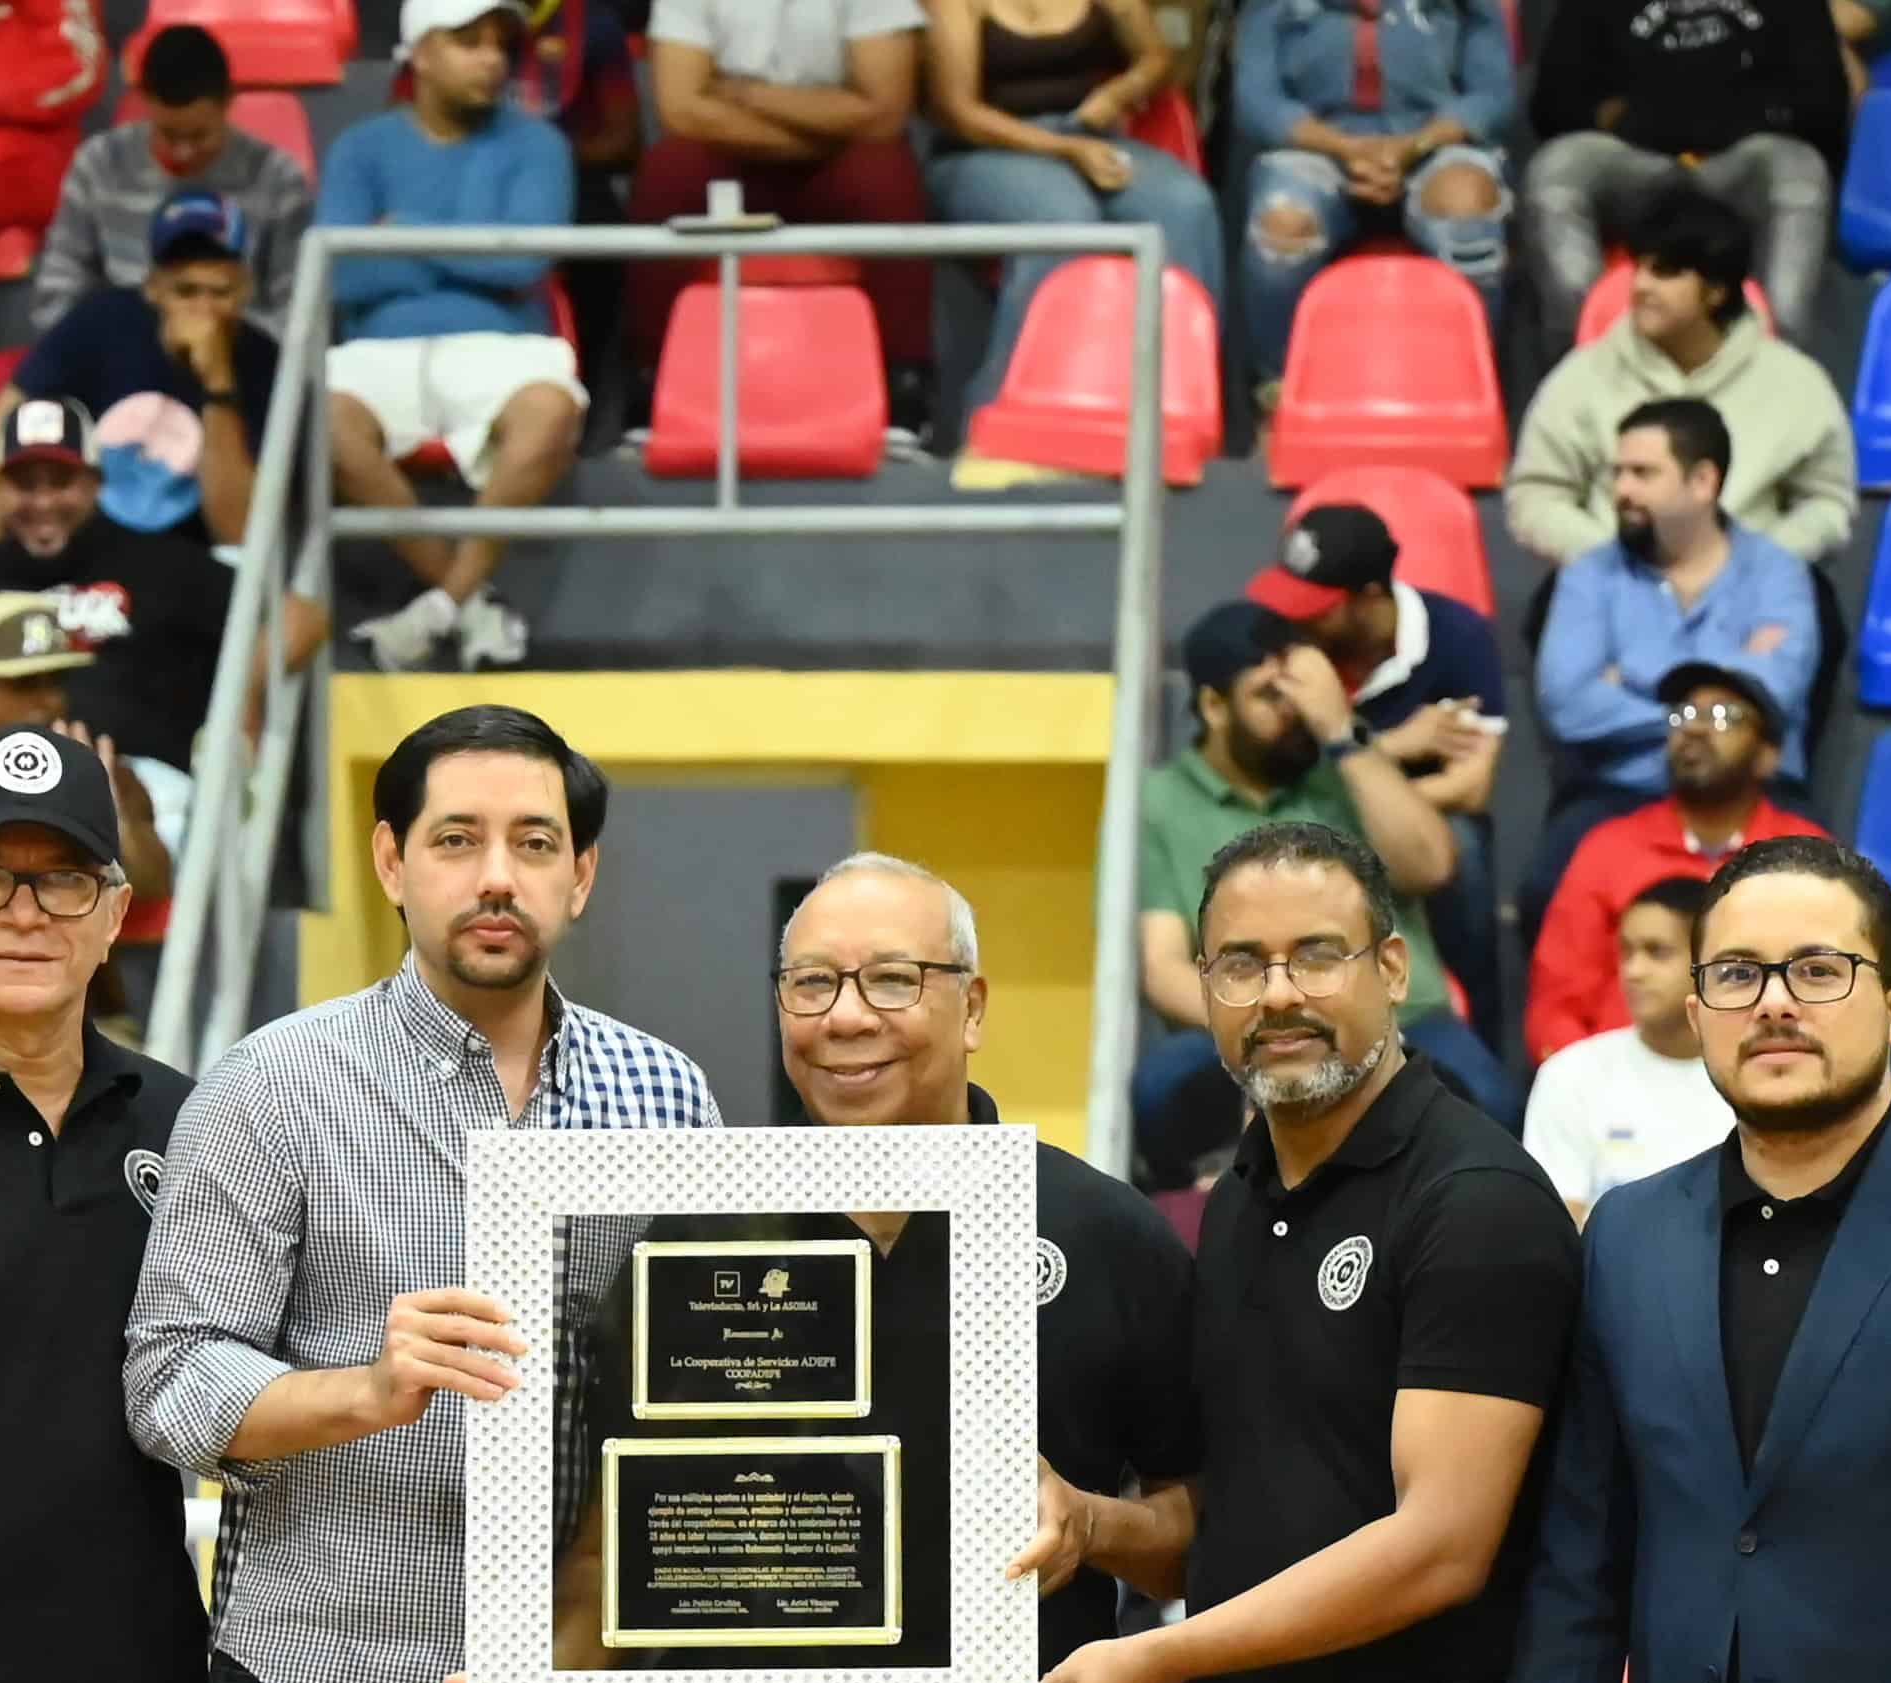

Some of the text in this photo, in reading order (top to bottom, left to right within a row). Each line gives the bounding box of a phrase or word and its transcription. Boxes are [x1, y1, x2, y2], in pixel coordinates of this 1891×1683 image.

[670, 1356, 682, 1367] La
[684, 1357, 741, 1369] Cooperativa
[743, 1357, 755, 1367] de
[757, 1357, 799, 1368] Servicios
